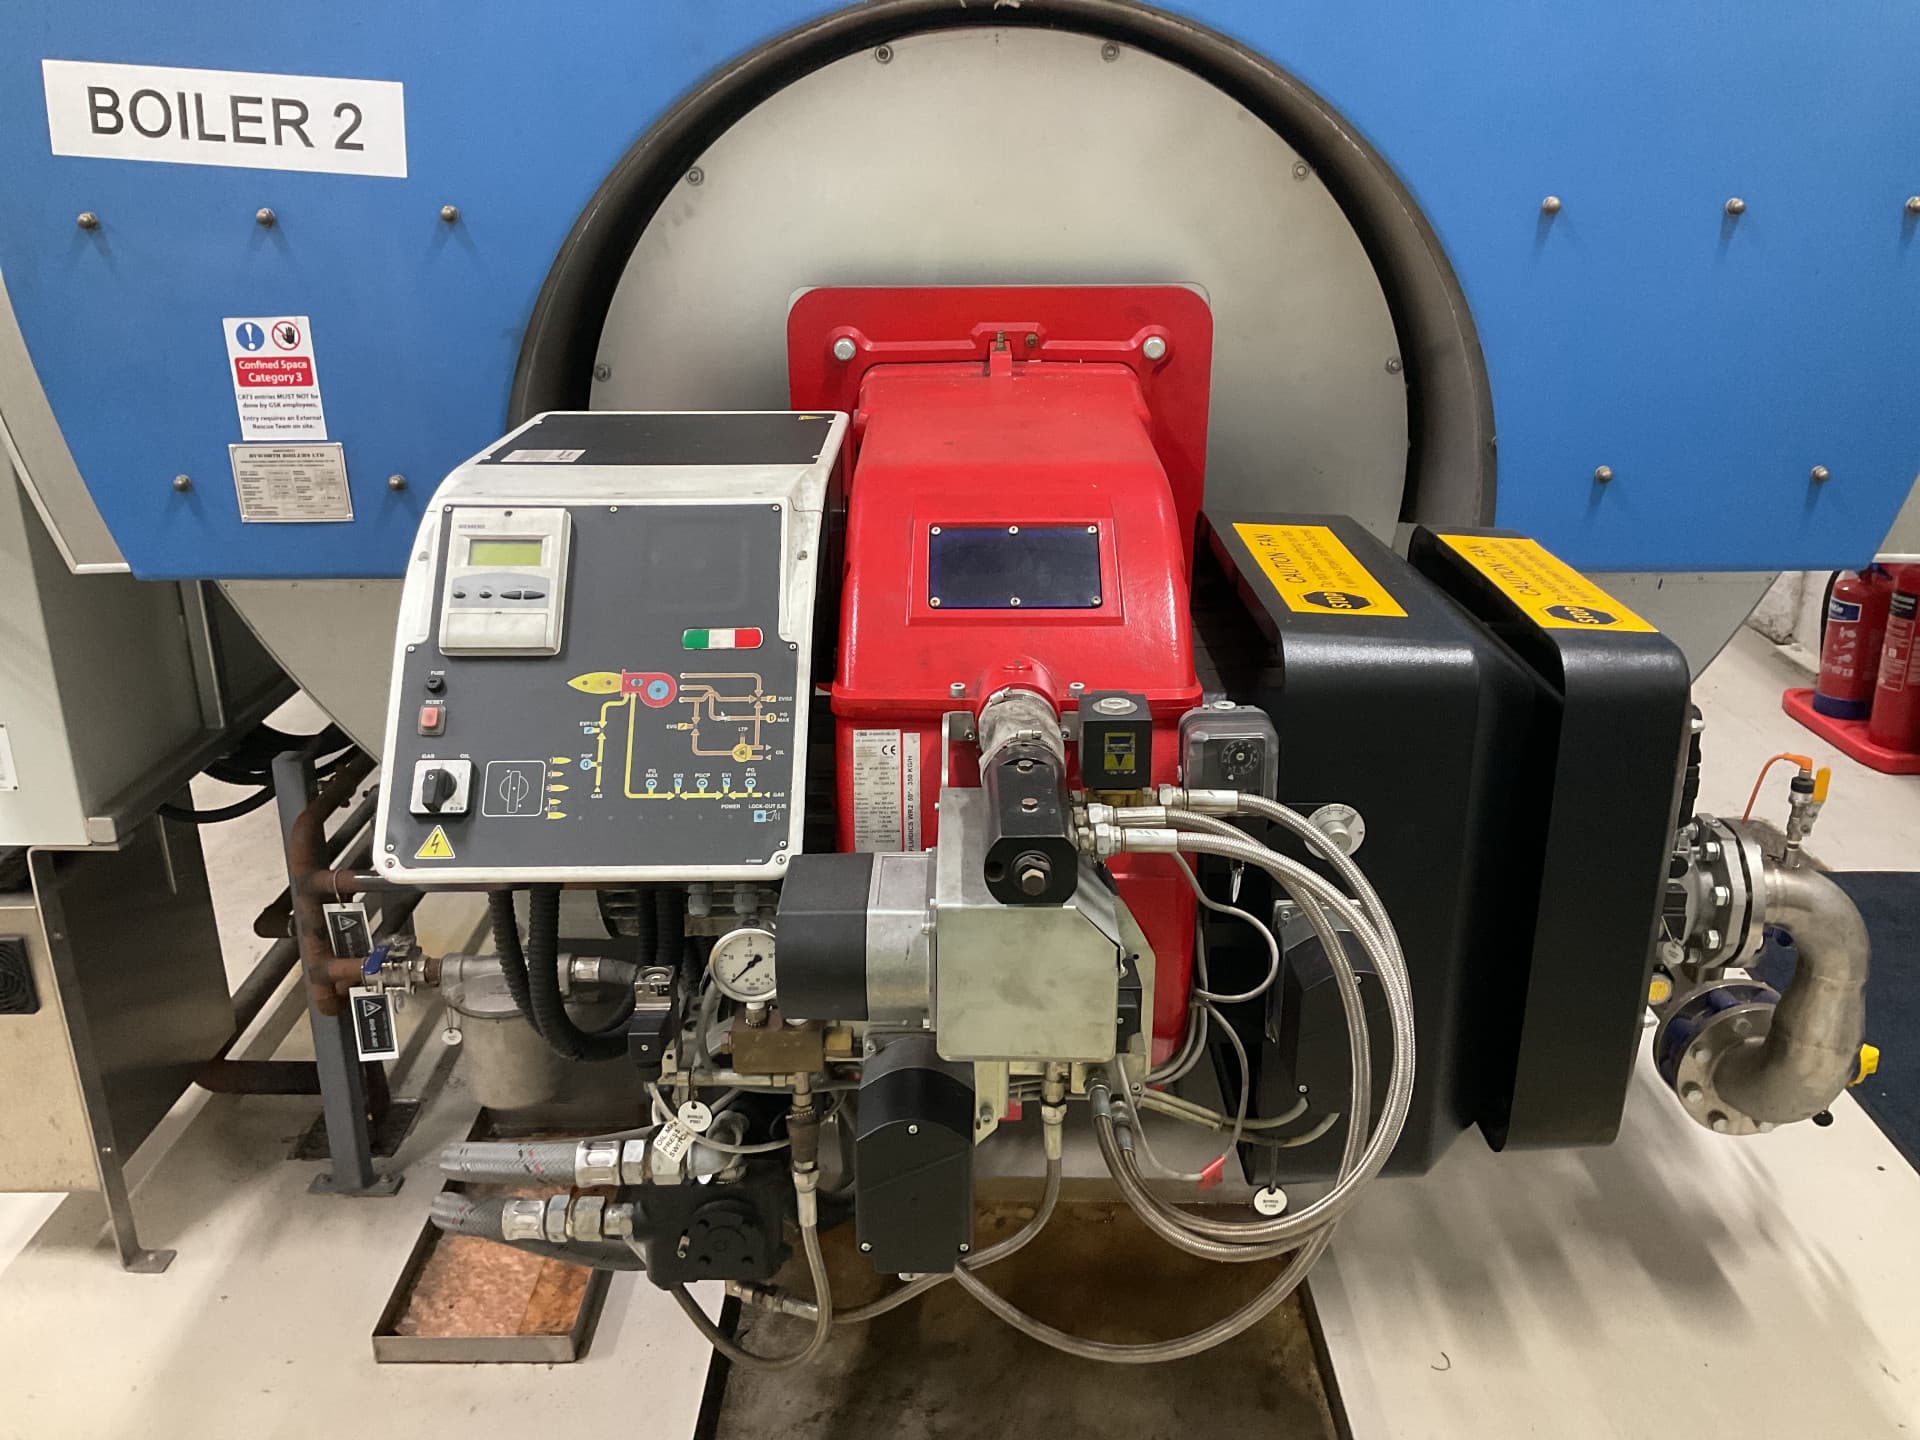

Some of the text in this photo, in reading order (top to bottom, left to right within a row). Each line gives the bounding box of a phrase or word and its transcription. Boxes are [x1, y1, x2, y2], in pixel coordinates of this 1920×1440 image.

[87, 86, 364, 151] BOILER 2
[239, 361, 307, 370] Confined Space
[248, 373, 302, 384] Category 3
[1254, 533, 1278, 547] FAN
[1465, 545, 1491, 558] FAN
[1268, 551, 1306, 584] CAUTION
[1487, 561, 1541, 597] CAUTION
[1324, 592, 1352, 609] STOP
[1564, 607, 1599, 624] STOP
[657, 1134, 667, 1145] OIL
